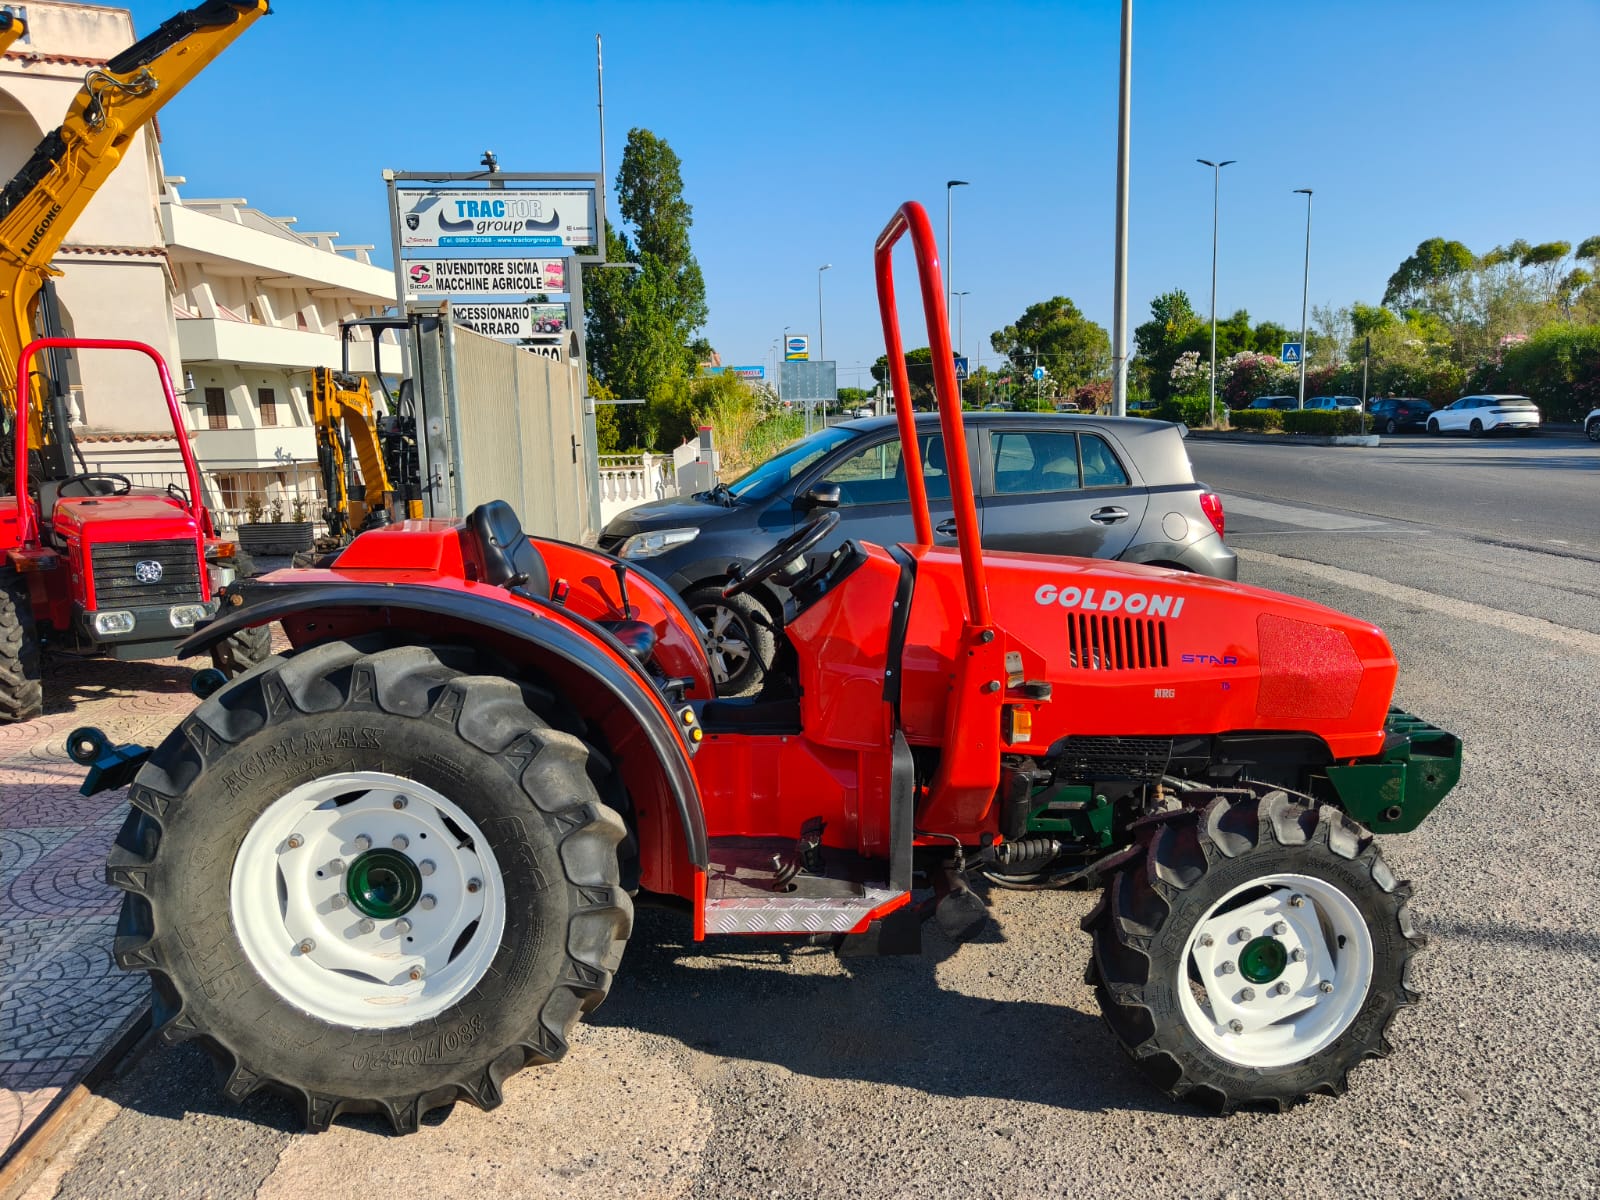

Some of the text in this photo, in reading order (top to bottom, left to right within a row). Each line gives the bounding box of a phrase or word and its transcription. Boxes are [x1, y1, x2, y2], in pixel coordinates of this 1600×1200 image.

[455, 199, 542, 217] TRACTOR
[21, 203, 62, 256] LIUGONG
[477, 220, 523, 234] group
[436, 262, 539, 275] RIVENDITORE SICMA
[435, 277, 543, 291] MACCHINE AGRICOLE
[1034, 584, 1185, 618] GOLDONI
[1181, 653, 1238, 665] STAR
[1154, 688, 1176, 698] NRG
